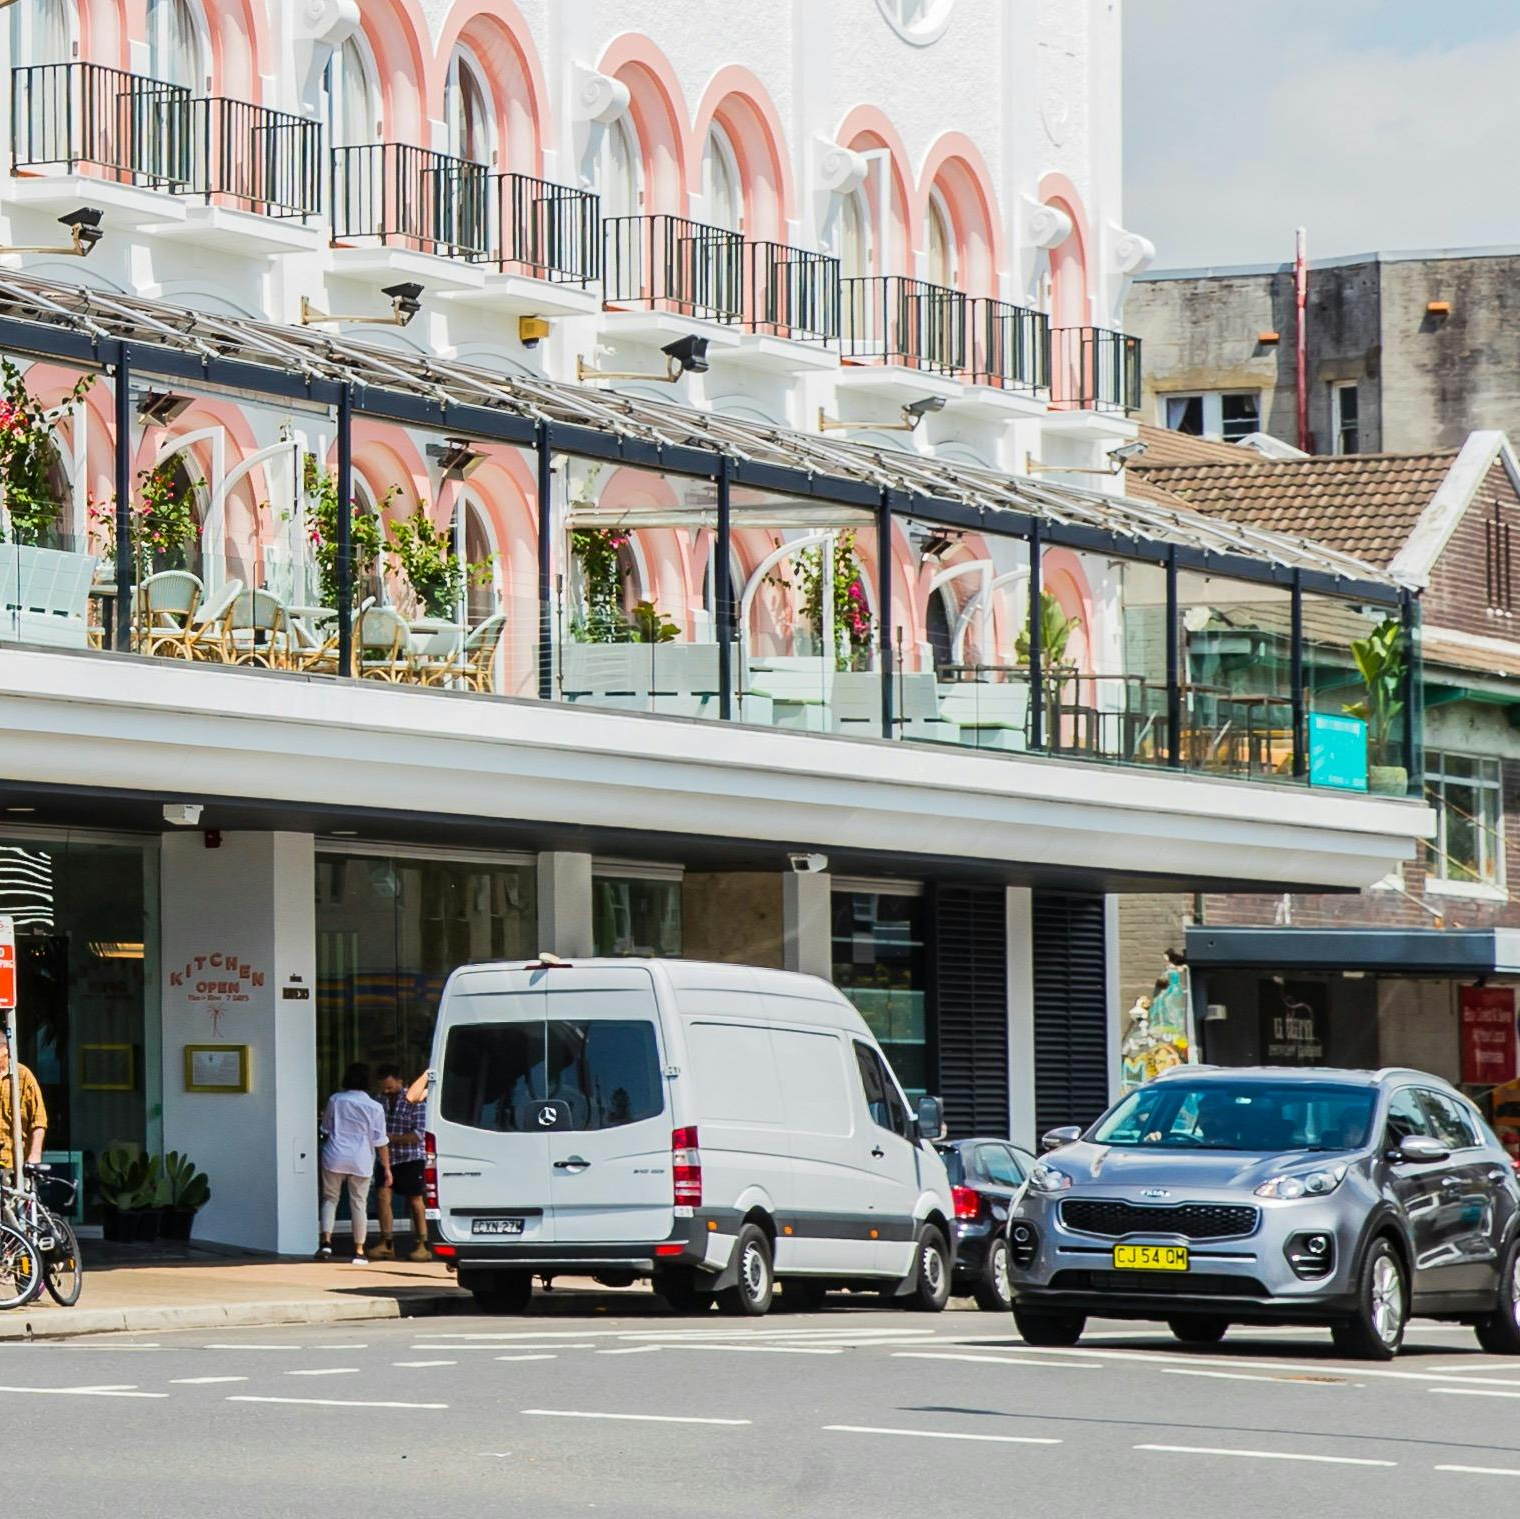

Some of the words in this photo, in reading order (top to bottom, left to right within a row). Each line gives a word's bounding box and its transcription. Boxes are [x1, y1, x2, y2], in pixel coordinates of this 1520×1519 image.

[169, 952, 265, 987] KITCHEN
[196, 981, 240, 994] OPEN
[1117, 1247, 1136, 1264] CJ
[1141, 1248, 1160, 1264] 54
